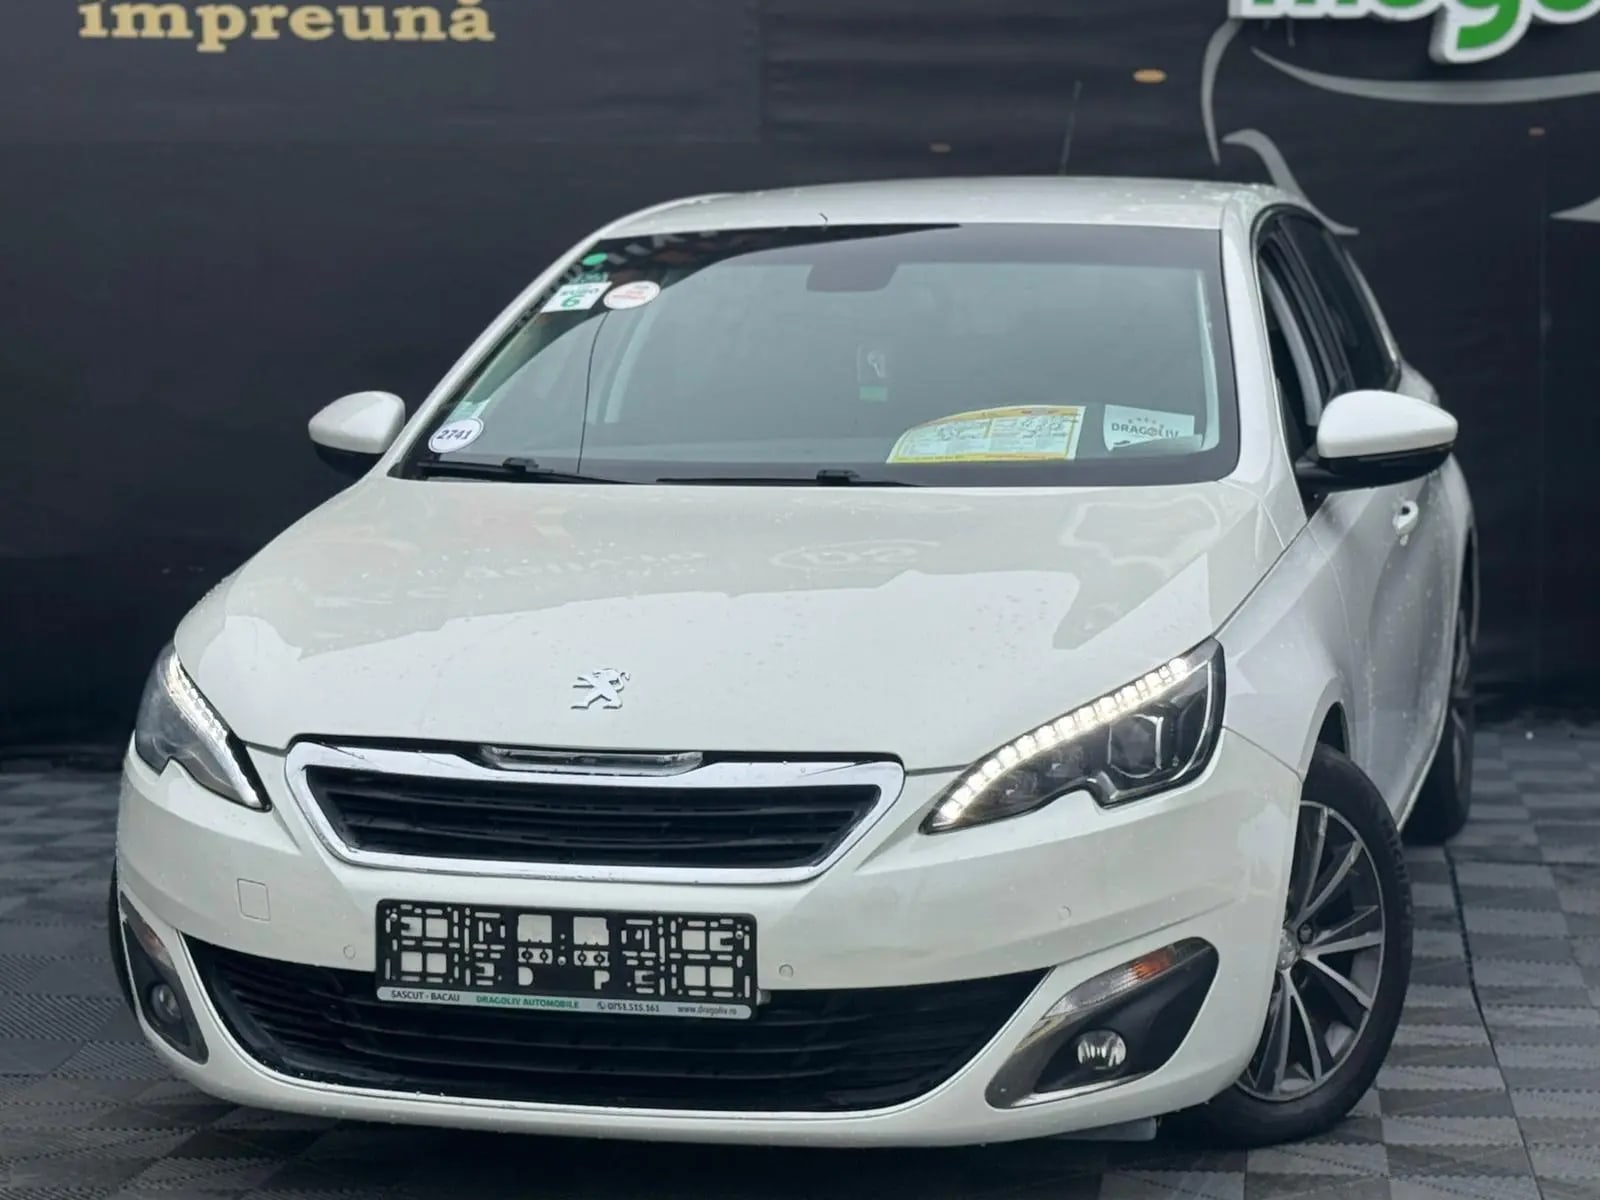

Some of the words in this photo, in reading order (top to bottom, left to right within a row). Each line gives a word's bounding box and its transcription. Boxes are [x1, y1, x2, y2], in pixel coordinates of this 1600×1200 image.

[436, 429, 473, 440] 2741
[391, 989, 424, 1000] SASCUT
[430, 992, 460, 1002] BACAU
[523, 998, 580, 1009] AUTOMOBILE
